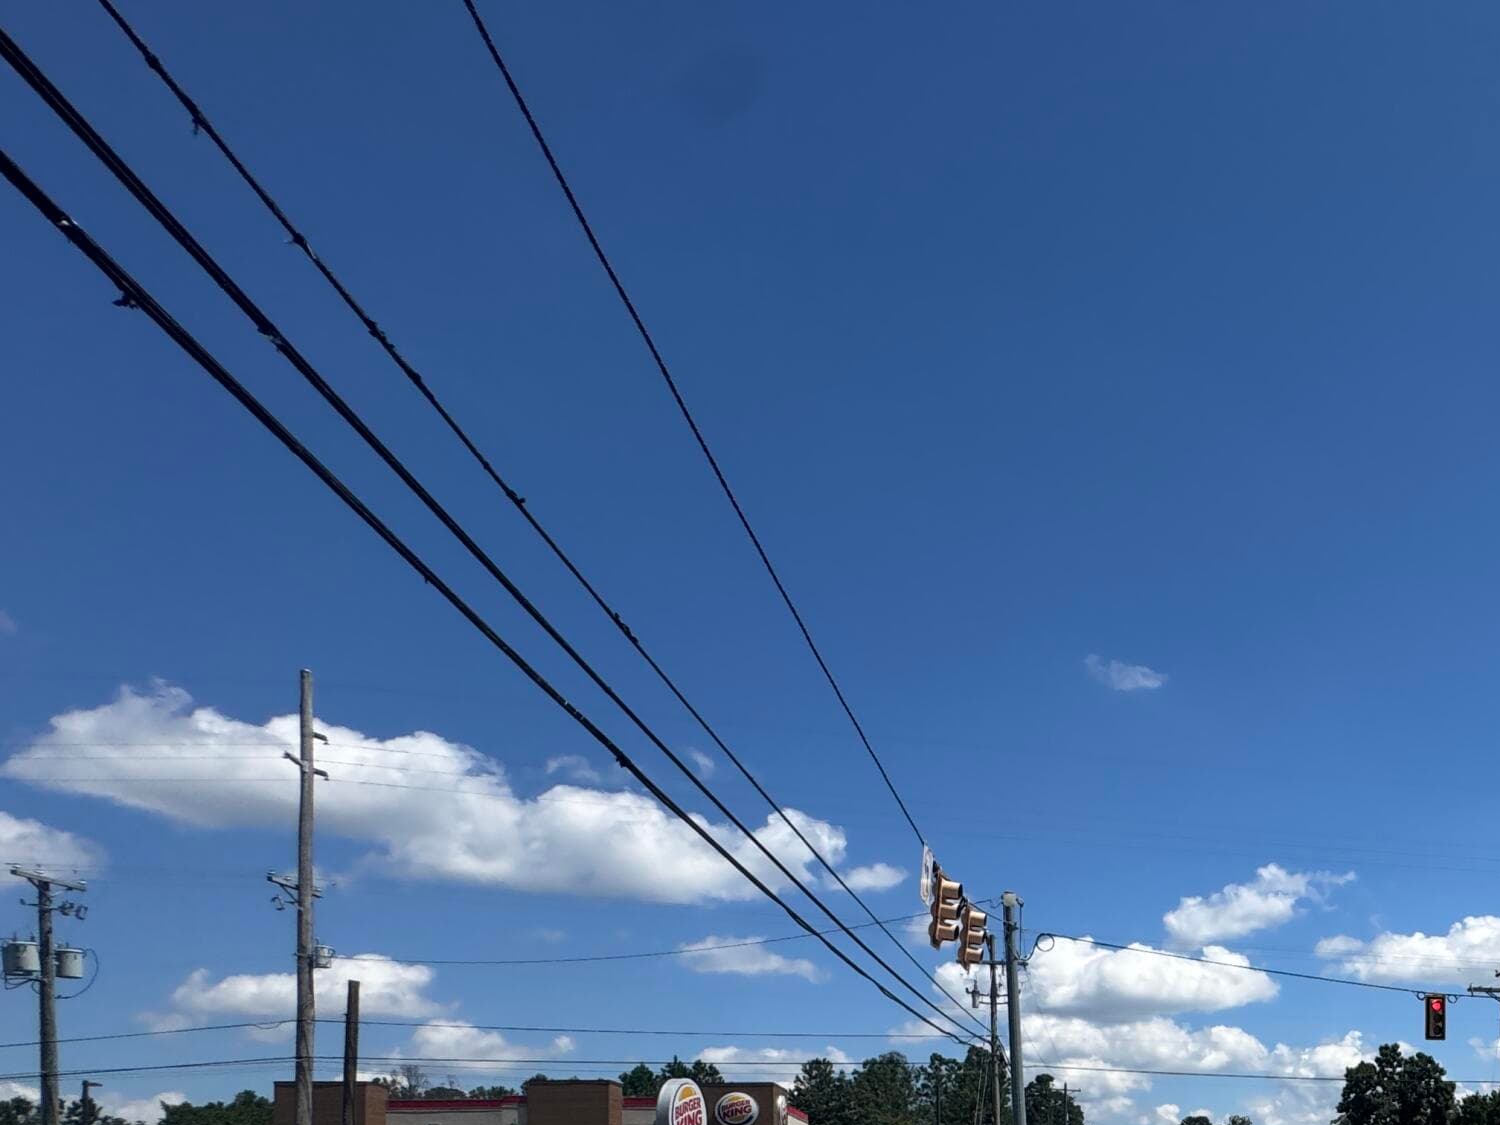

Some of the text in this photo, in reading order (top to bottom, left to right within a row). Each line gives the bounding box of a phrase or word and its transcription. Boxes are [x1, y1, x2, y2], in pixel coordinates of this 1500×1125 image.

[675, 1097, 701, 1120] BURGER
[722, 1100, 751, 1111] BURGER
[723, 1105, 752, 1119] KING
